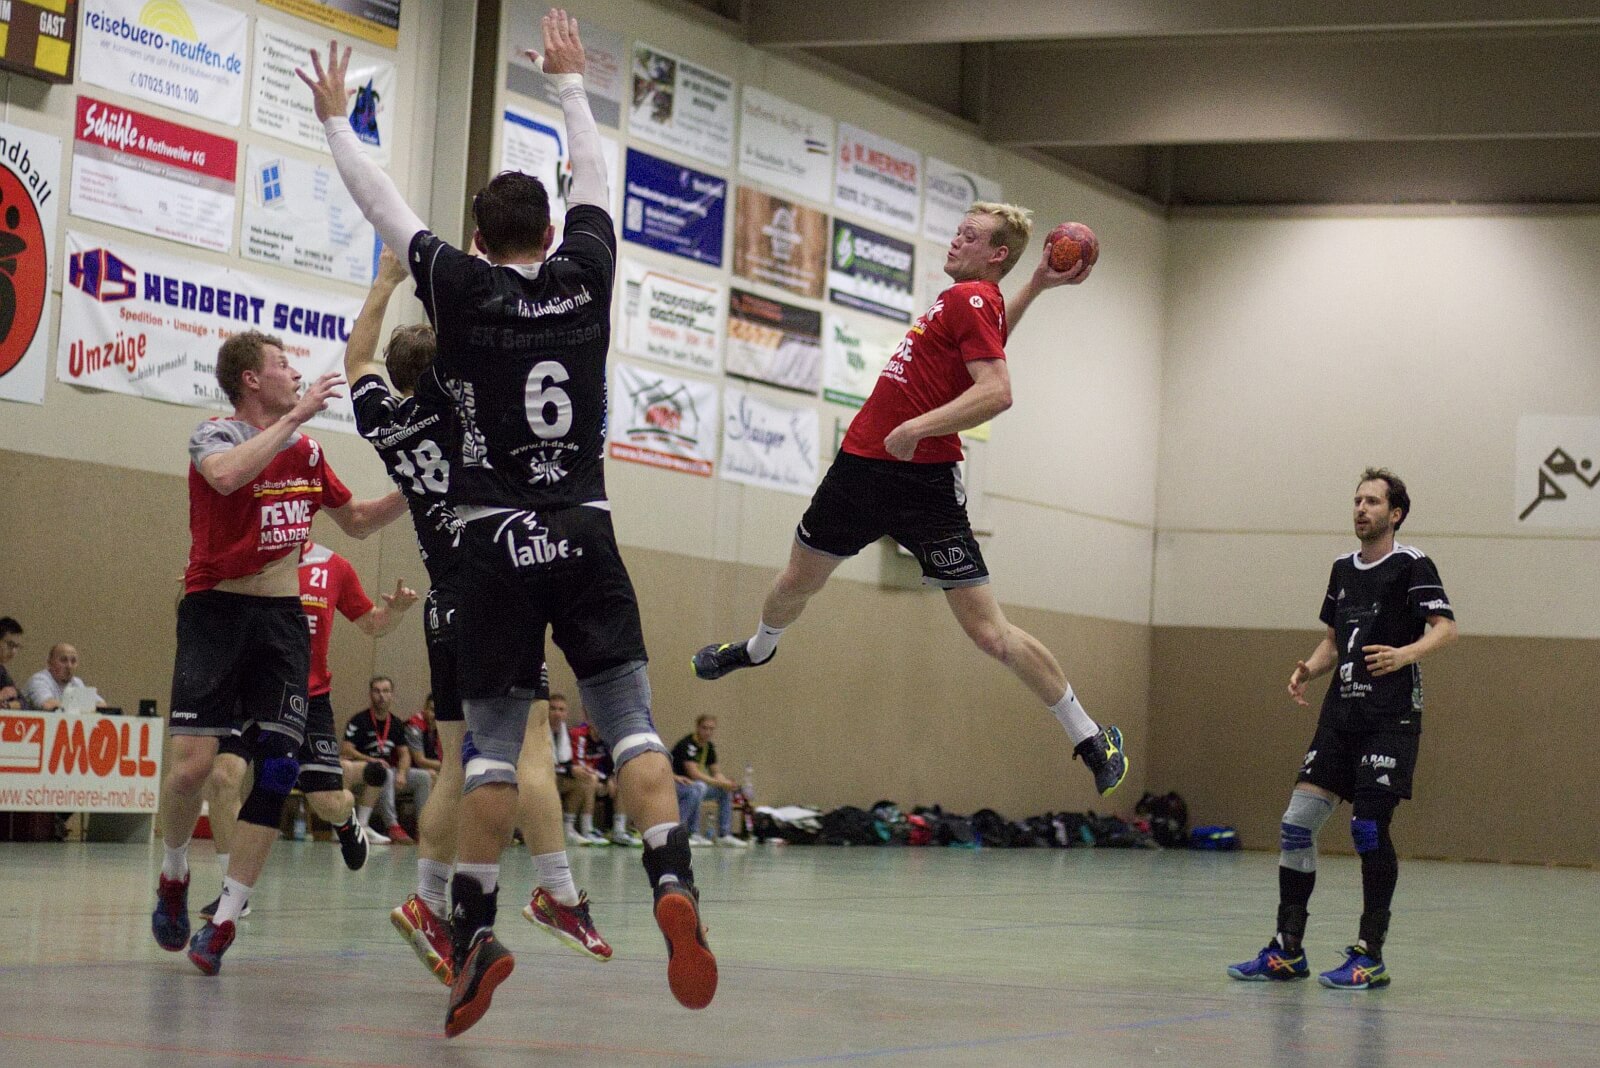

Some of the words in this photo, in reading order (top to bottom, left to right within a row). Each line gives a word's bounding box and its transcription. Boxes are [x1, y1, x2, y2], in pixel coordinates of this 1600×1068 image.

[39, 11, 66, 38] GAST
[85, 10, 242, 75] reisebuero-neuffen.de
[138, 71, 199, 104] 07025.910.100
[83, 102, 138, 151] Schühle
[146, 137, 193, 160] Rothweiler
[192, 150, 206, 167] KG
[119, 307, 164, 327] Spedition
[173, 318, 209, 337] Umzüge
[144, 272, 265, 325] HERBERT
[273, 302, 357, 343] SCHAL
[68, 331, 147, 379] Umzüge
[525, 360, 574, 440] 6
[308, 439, 320, 468] 3
[509, 440, 580, 457] www.fi-da.de
[310, 477, 322, 487] AG
[309, 567, 329, 590] 21
[48, 718, 157, 778] MOLL
